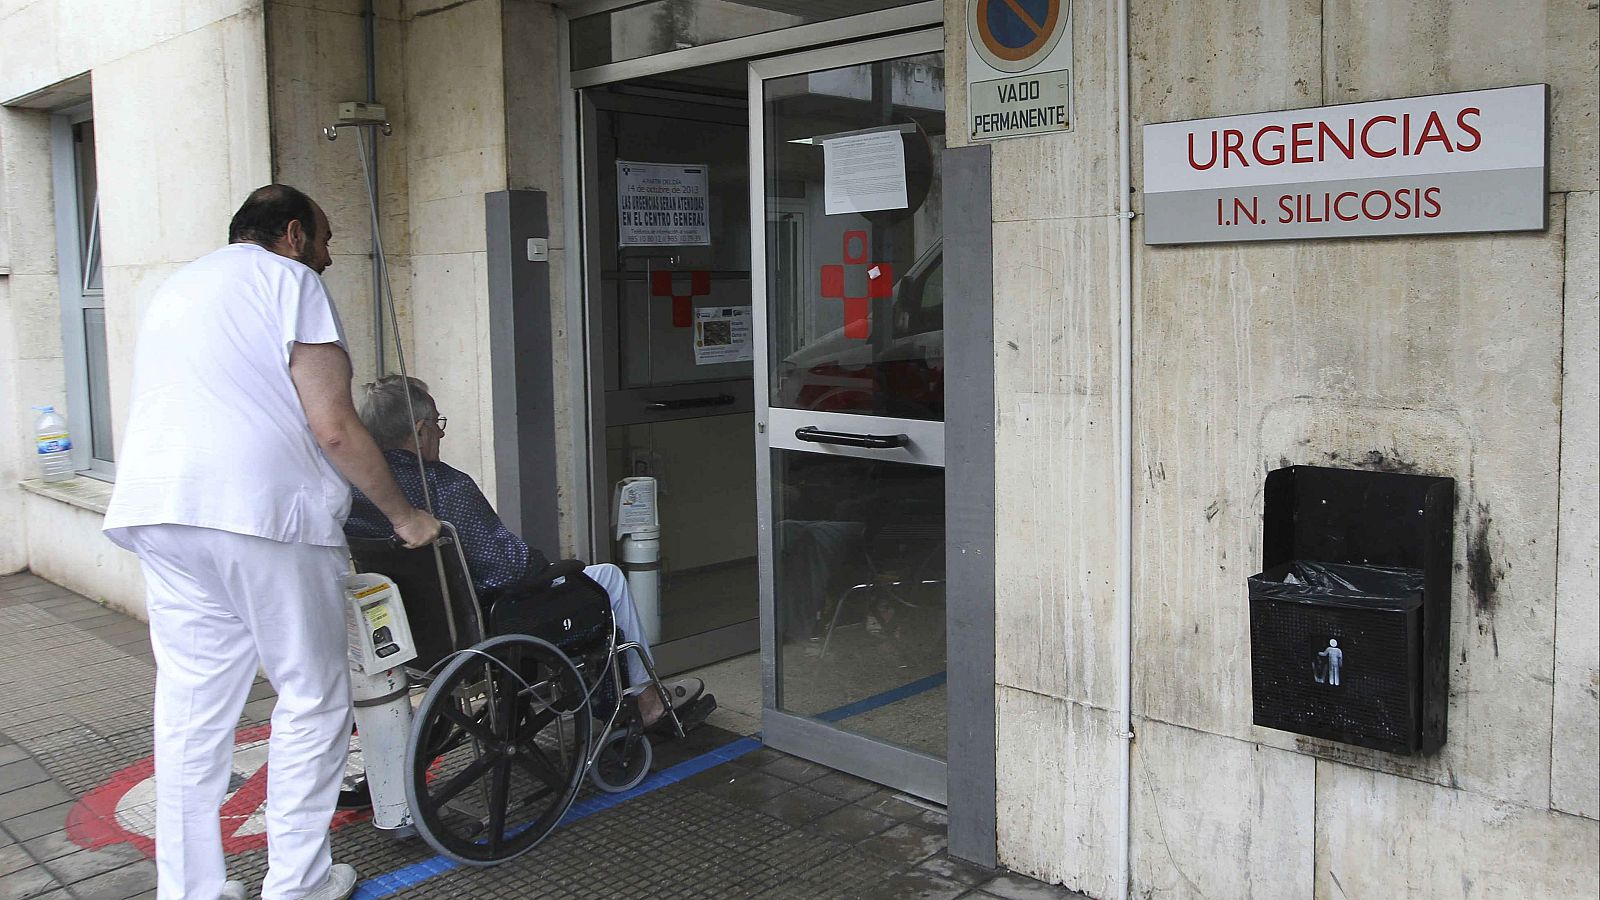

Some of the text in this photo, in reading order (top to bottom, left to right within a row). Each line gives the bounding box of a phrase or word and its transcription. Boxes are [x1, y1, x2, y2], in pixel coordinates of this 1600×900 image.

[998, 81, 1040, 104] VADO
[974, 105, 1065, 133] PERMANENTE
[1187, 107, 1482, 171] URGENCIAS
[637, 185, 645, 193] de
[646, 186, 670, 194] octubre
[682, 185, 699, 194] 2013
[622, 195, 631, 210] LAS
[632, 195, 660, 211] URGENCIAS
[678, 196, 704, 211] ATENDIDAS
[1217, 187, 1442, 227] I.N. SILICOSIS
[622, 211, 705, 227] EN EL CENTRO GENERAL
[563, 618, 572, 631] 9
